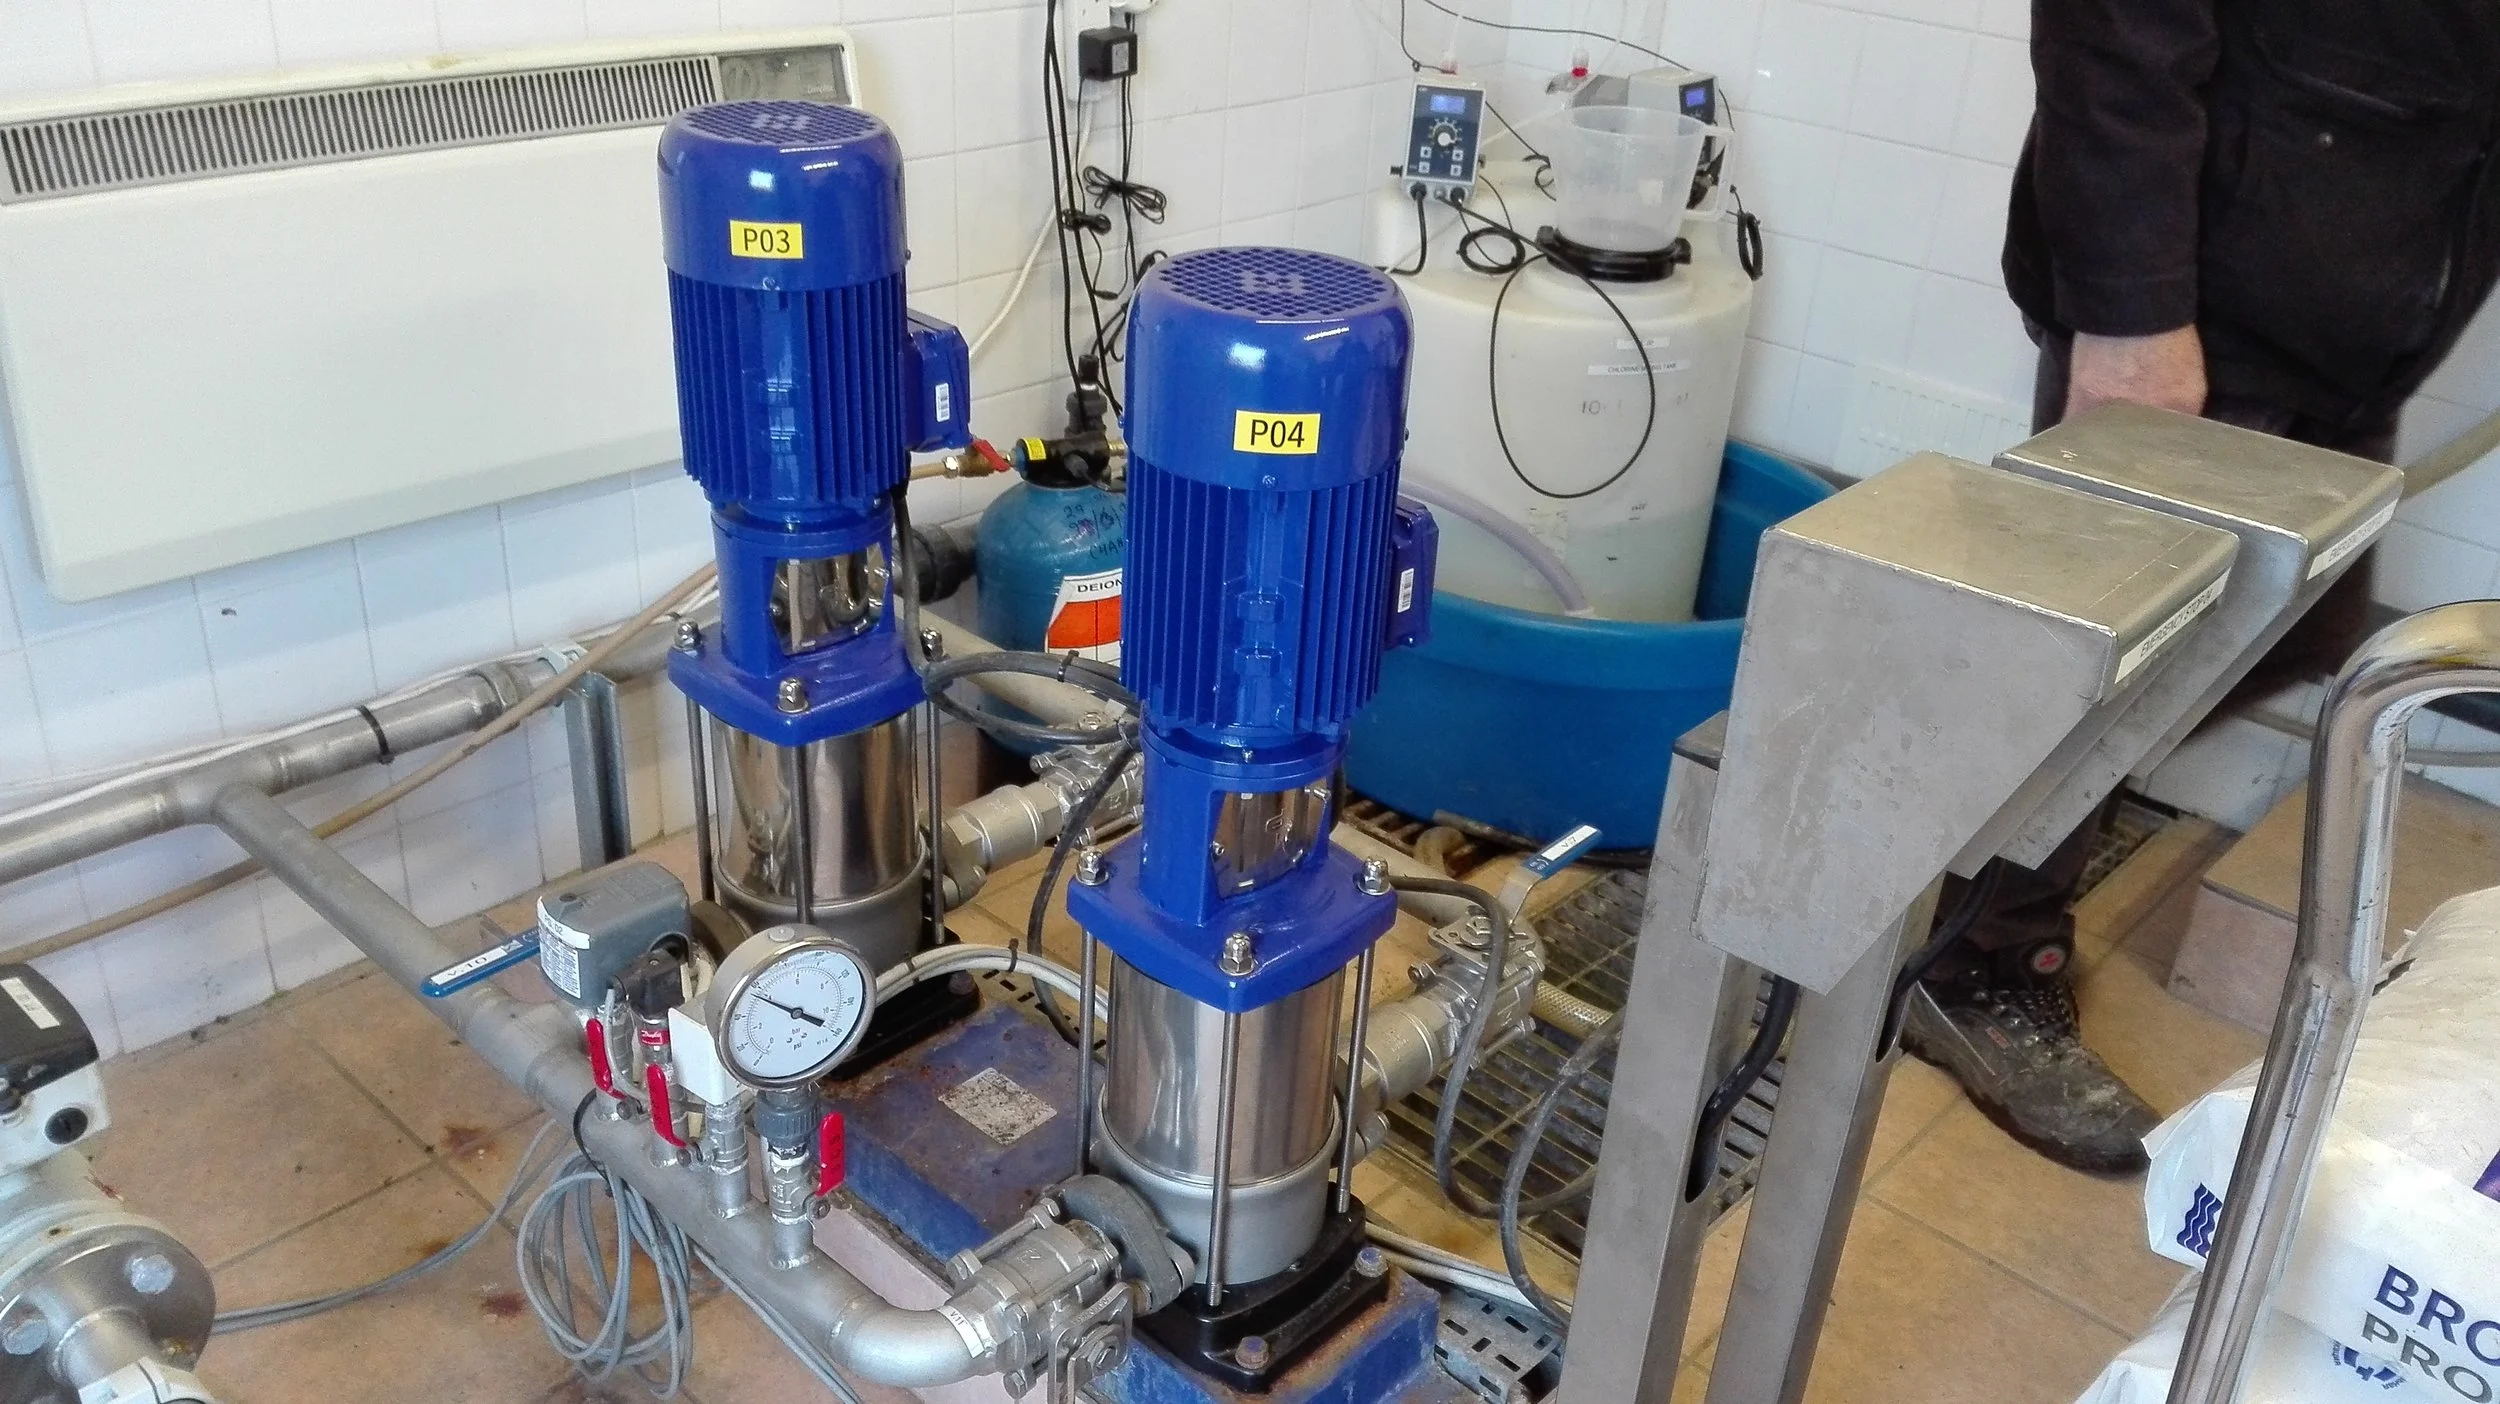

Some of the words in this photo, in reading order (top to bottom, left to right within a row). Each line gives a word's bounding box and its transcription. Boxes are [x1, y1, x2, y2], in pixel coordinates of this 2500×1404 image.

[743, 228, 790, 253] P03
[1250, 419, 1305, 448] P04
[2361, 1310, 2493, 1404] PRO
